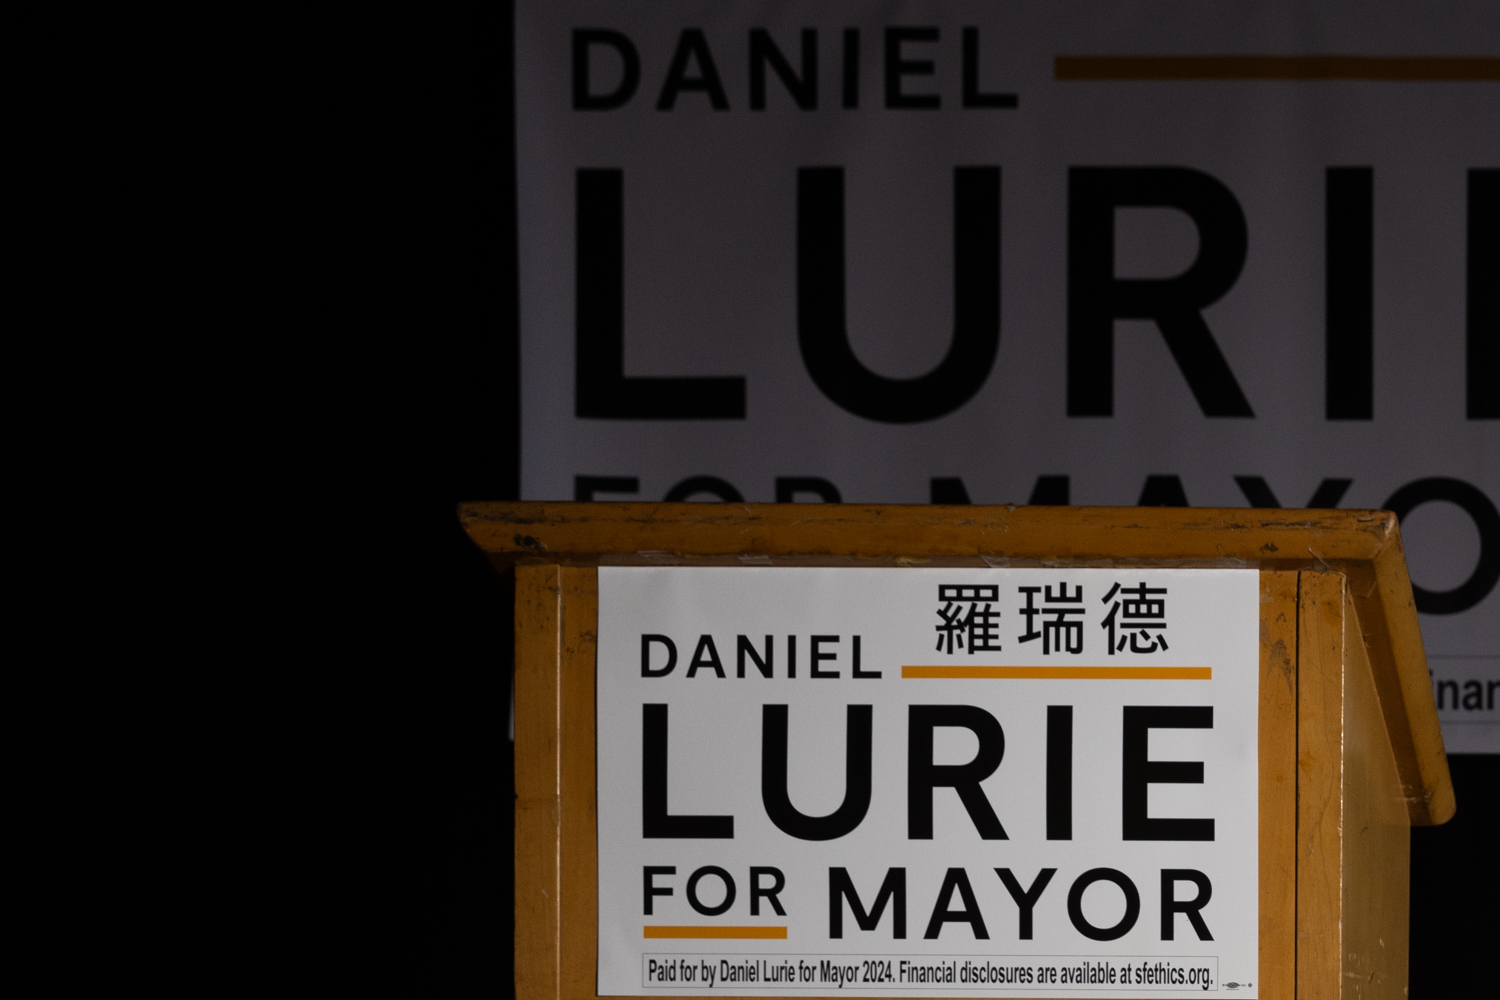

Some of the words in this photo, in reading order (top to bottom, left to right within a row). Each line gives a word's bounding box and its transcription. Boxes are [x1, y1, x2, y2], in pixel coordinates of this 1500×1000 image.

[572, 27, 1018, 110] DANIEL
[935, 582, 1169, 655] 羅瑞德
[641, 634, 882, 679] DANIEL
[642, 703, 1215, 842] LURIE
[643, 865, 786, 917] FOR
[828, 866, 1214, 942] MAYOR
[648, 959, 677, 982] Paid
[679, 959, 698, 982] for
[701, 959, 717, 988] by
[720, 959, 760, 983] Daniel
[763, 960, 796, 983] Lurie
[798, 959, 817, 983] for
[820, 960, 860, 988] Mayor
[862, 960, 896, 983] 2024.
[899, 960, 956, 984] Financial
[960, 960, 1034, 984] disclosures
[1037, 966, 1057, 984] are
[1060, 961, 1117, 985] available
[1119, 963, 1132, 985] at
[1135, 961, 1213, 988] sfethics.org.
